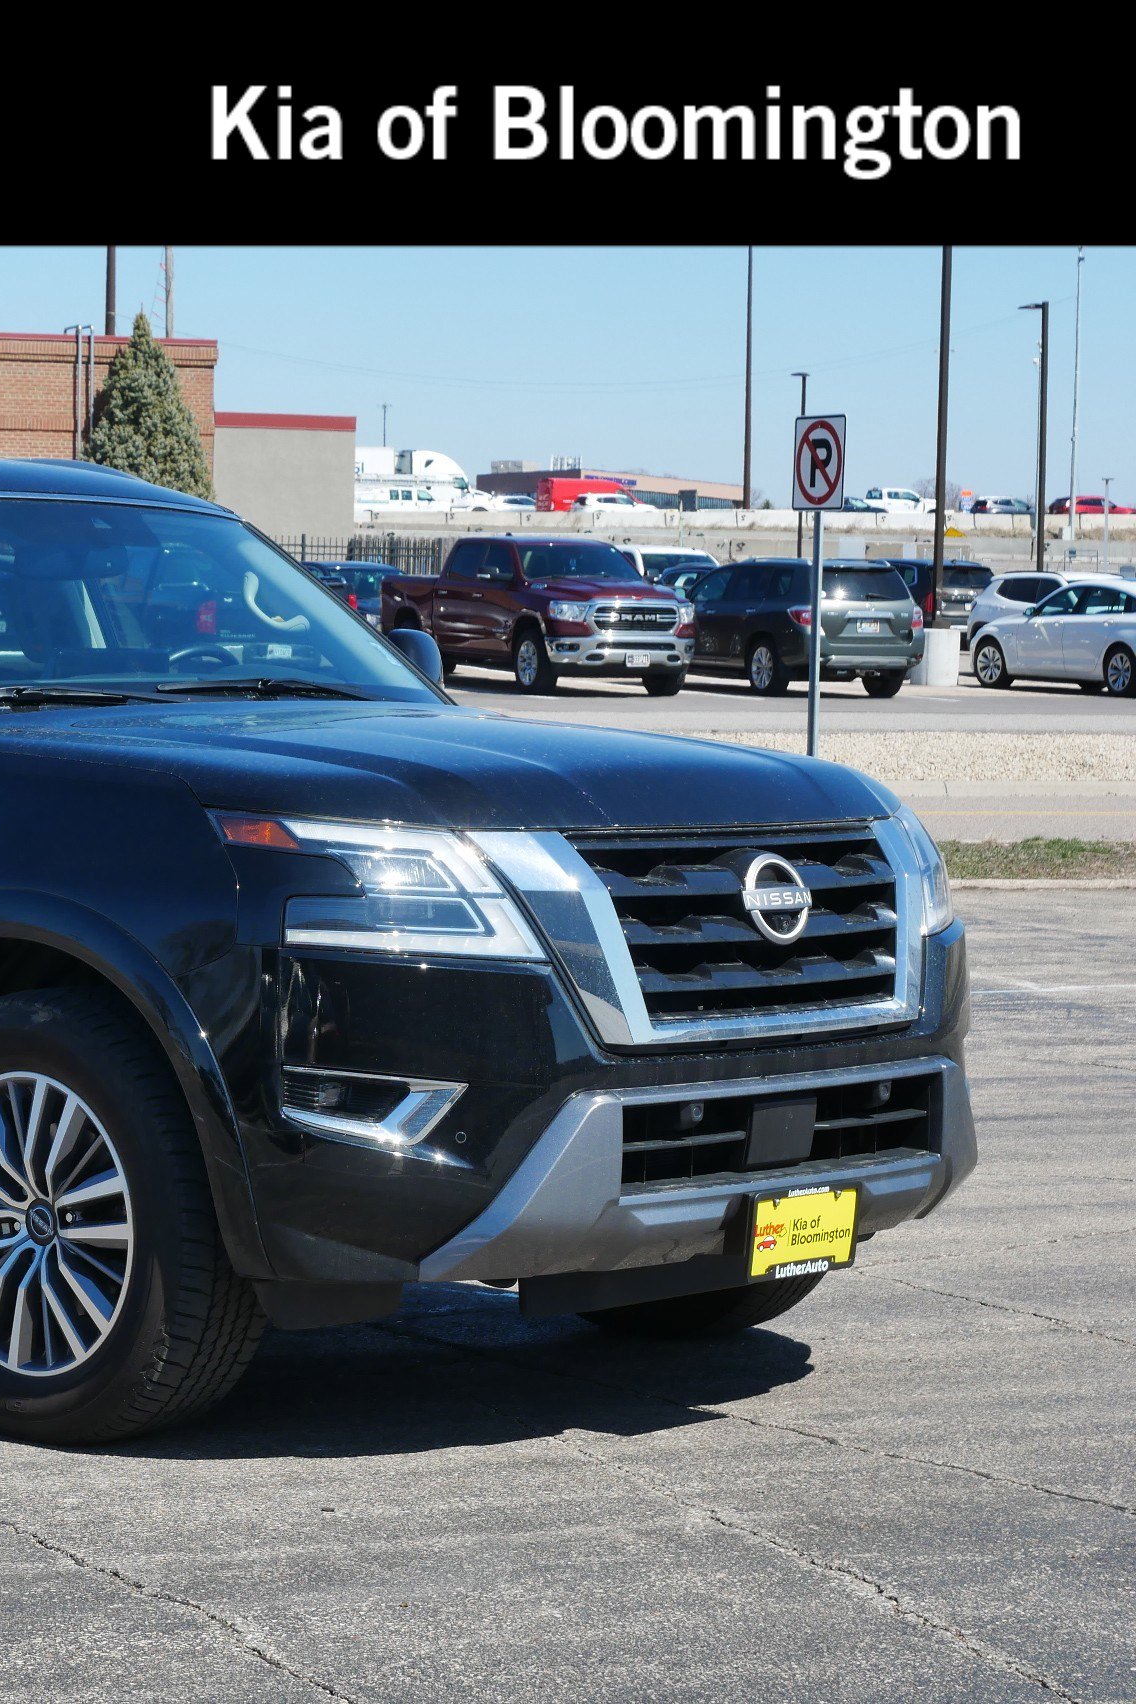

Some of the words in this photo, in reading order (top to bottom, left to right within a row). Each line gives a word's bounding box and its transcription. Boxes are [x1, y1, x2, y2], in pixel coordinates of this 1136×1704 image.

[621, 613, 656, 621] RAM
[746, 891, 811, 907] NISSAN
[788, 1186, 830, 1198] LutherAuto.com
[754, 1222, 785, 1237] Luther
[792, 1218, 808, 1232] Kia
[810, 1215, 821, 1228] of
[790, 1228, 851, 1247] Bloomington
[775, 1259, 829, 1279] LutherAuto
